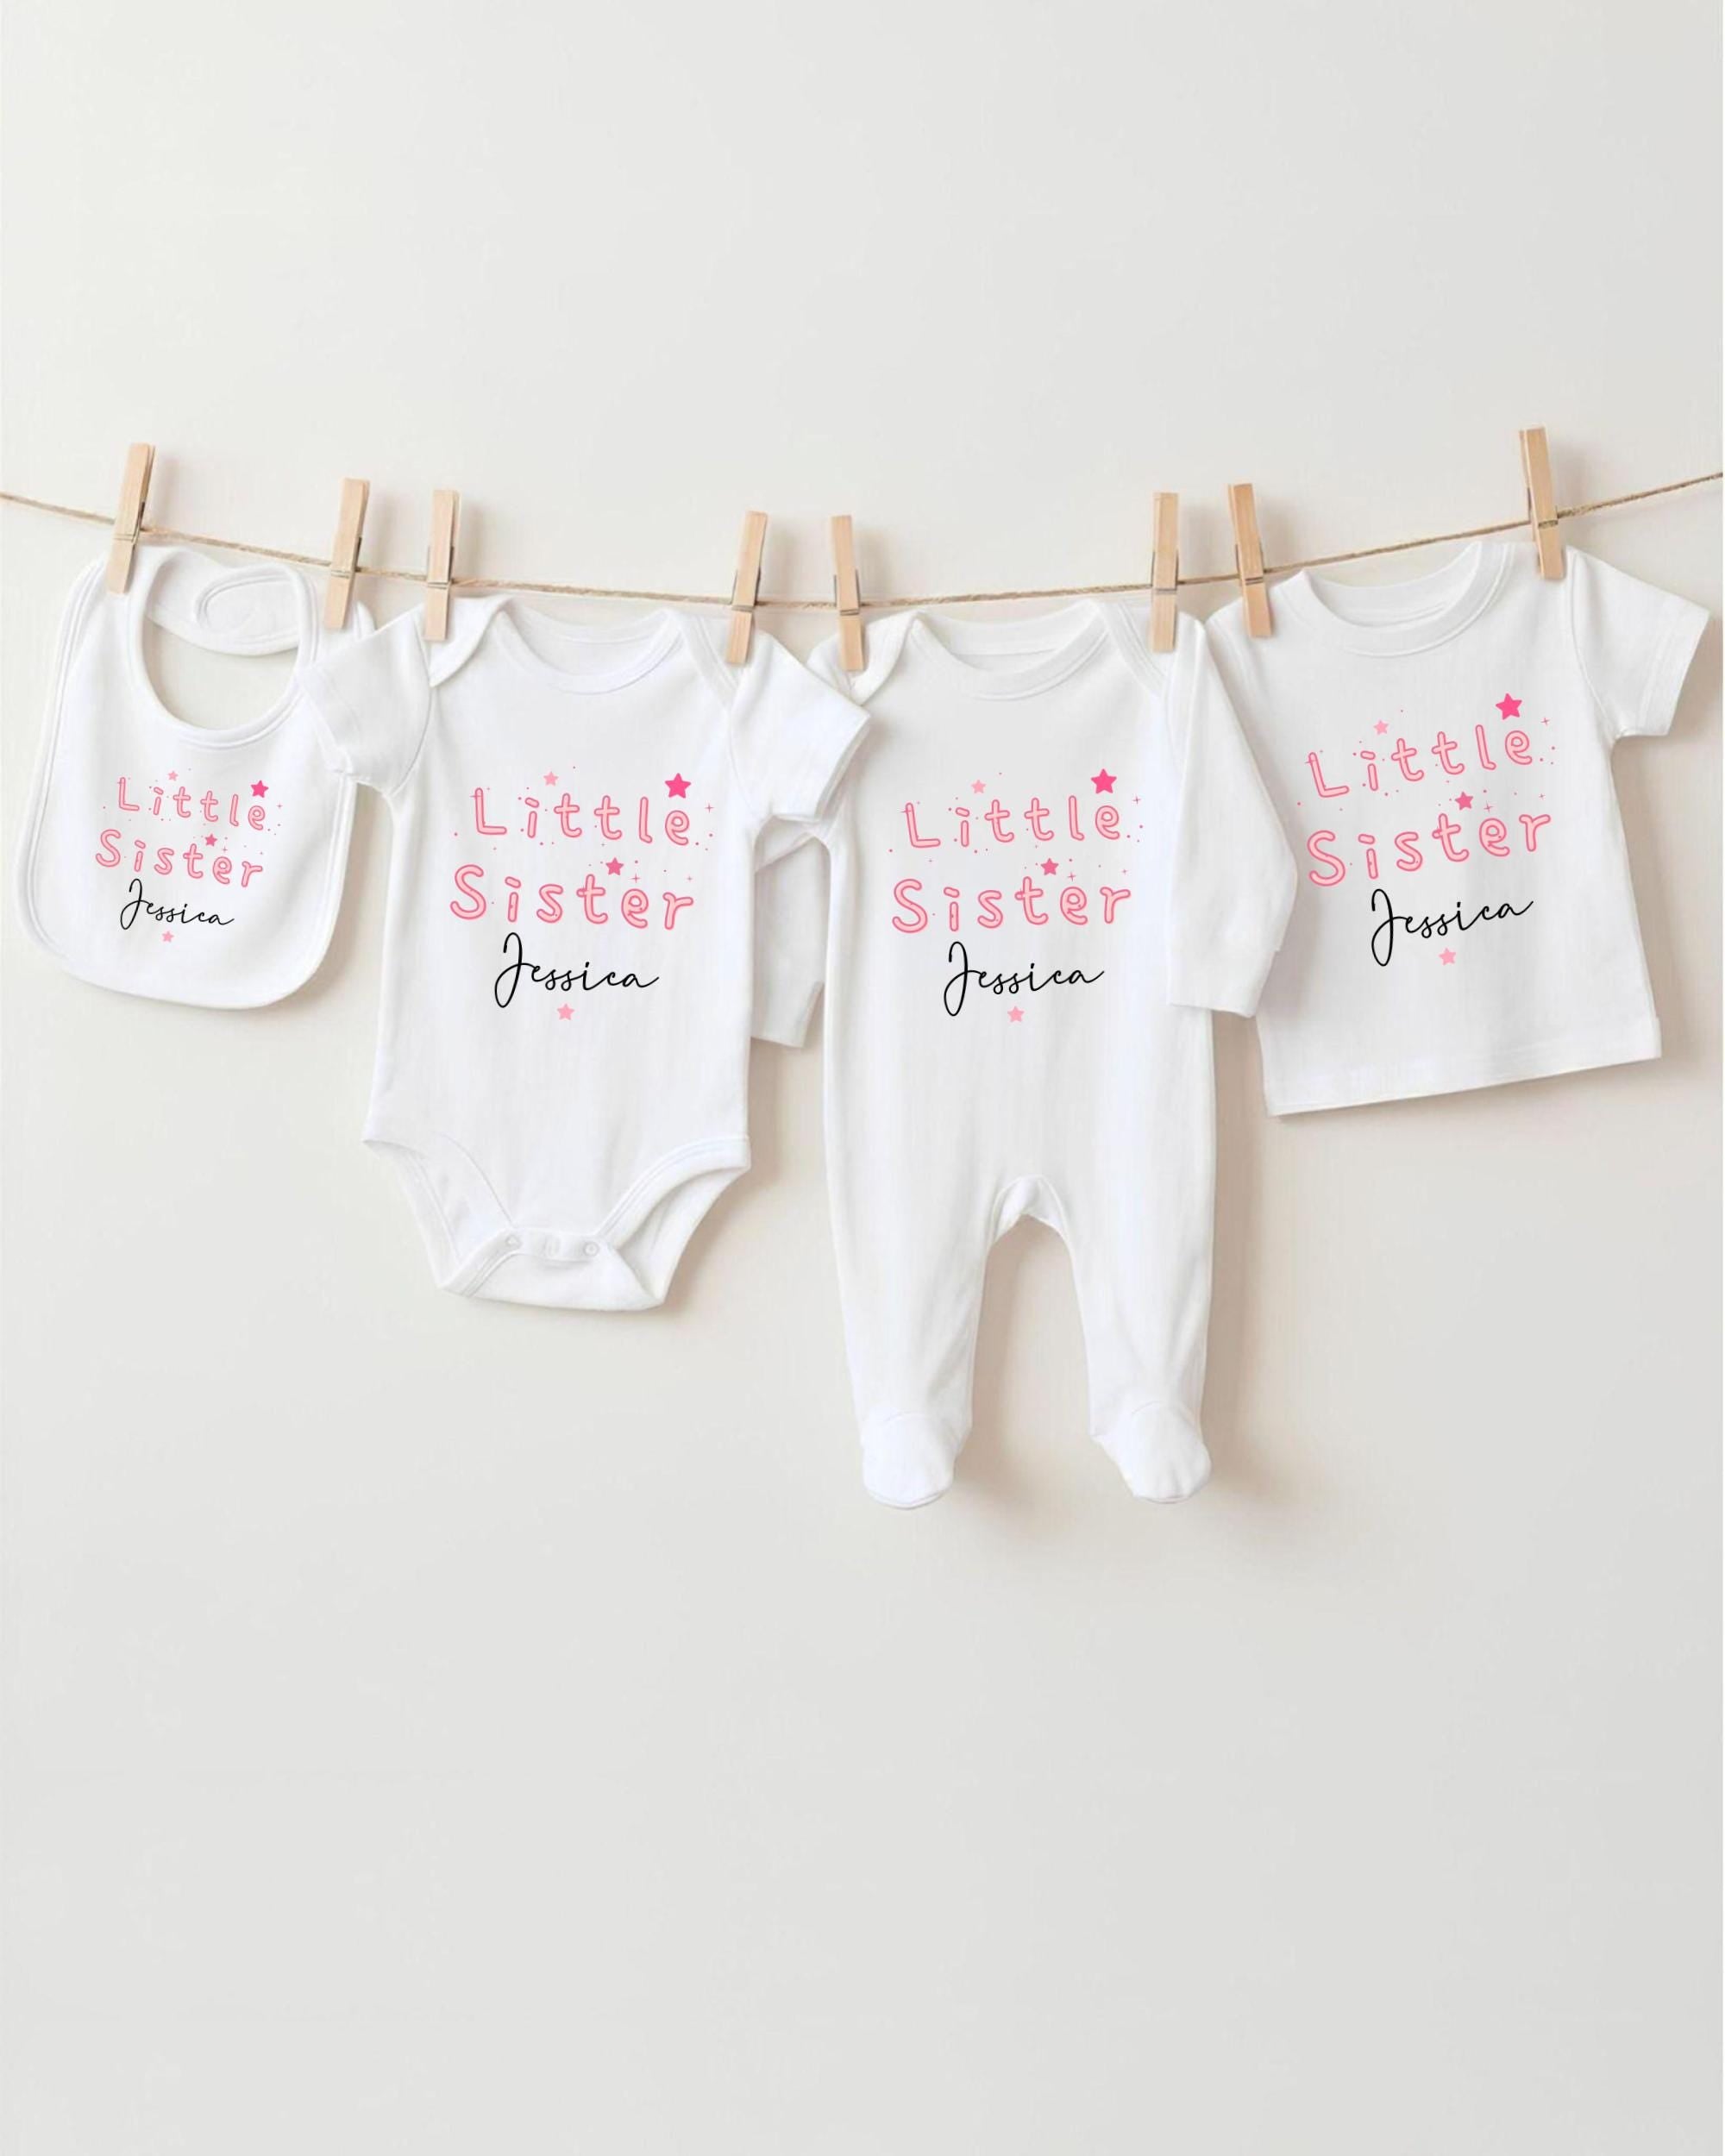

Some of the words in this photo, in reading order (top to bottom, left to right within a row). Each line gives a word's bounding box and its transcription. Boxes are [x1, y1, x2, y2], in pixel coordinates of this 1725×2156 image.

[1307, 724, 1534, 799] Little
[117, 776, 267, 831] Little
[472, 786, 692, 847] Little
[903, 795, 1121, 849] Little
[96, 828, 263, 888] Sister
[1306, 812, 1552, 887] Sister
[120, 878, 235, 931] Jessica
[448, 863, 694, 931] Sister
[891, 875, 1132, 935] Sister
[1371, 888, 1534, 967] Jessica
[494, 931, 660, 1009] Jessica
[943, 941, 1105, 1017] Jessica
